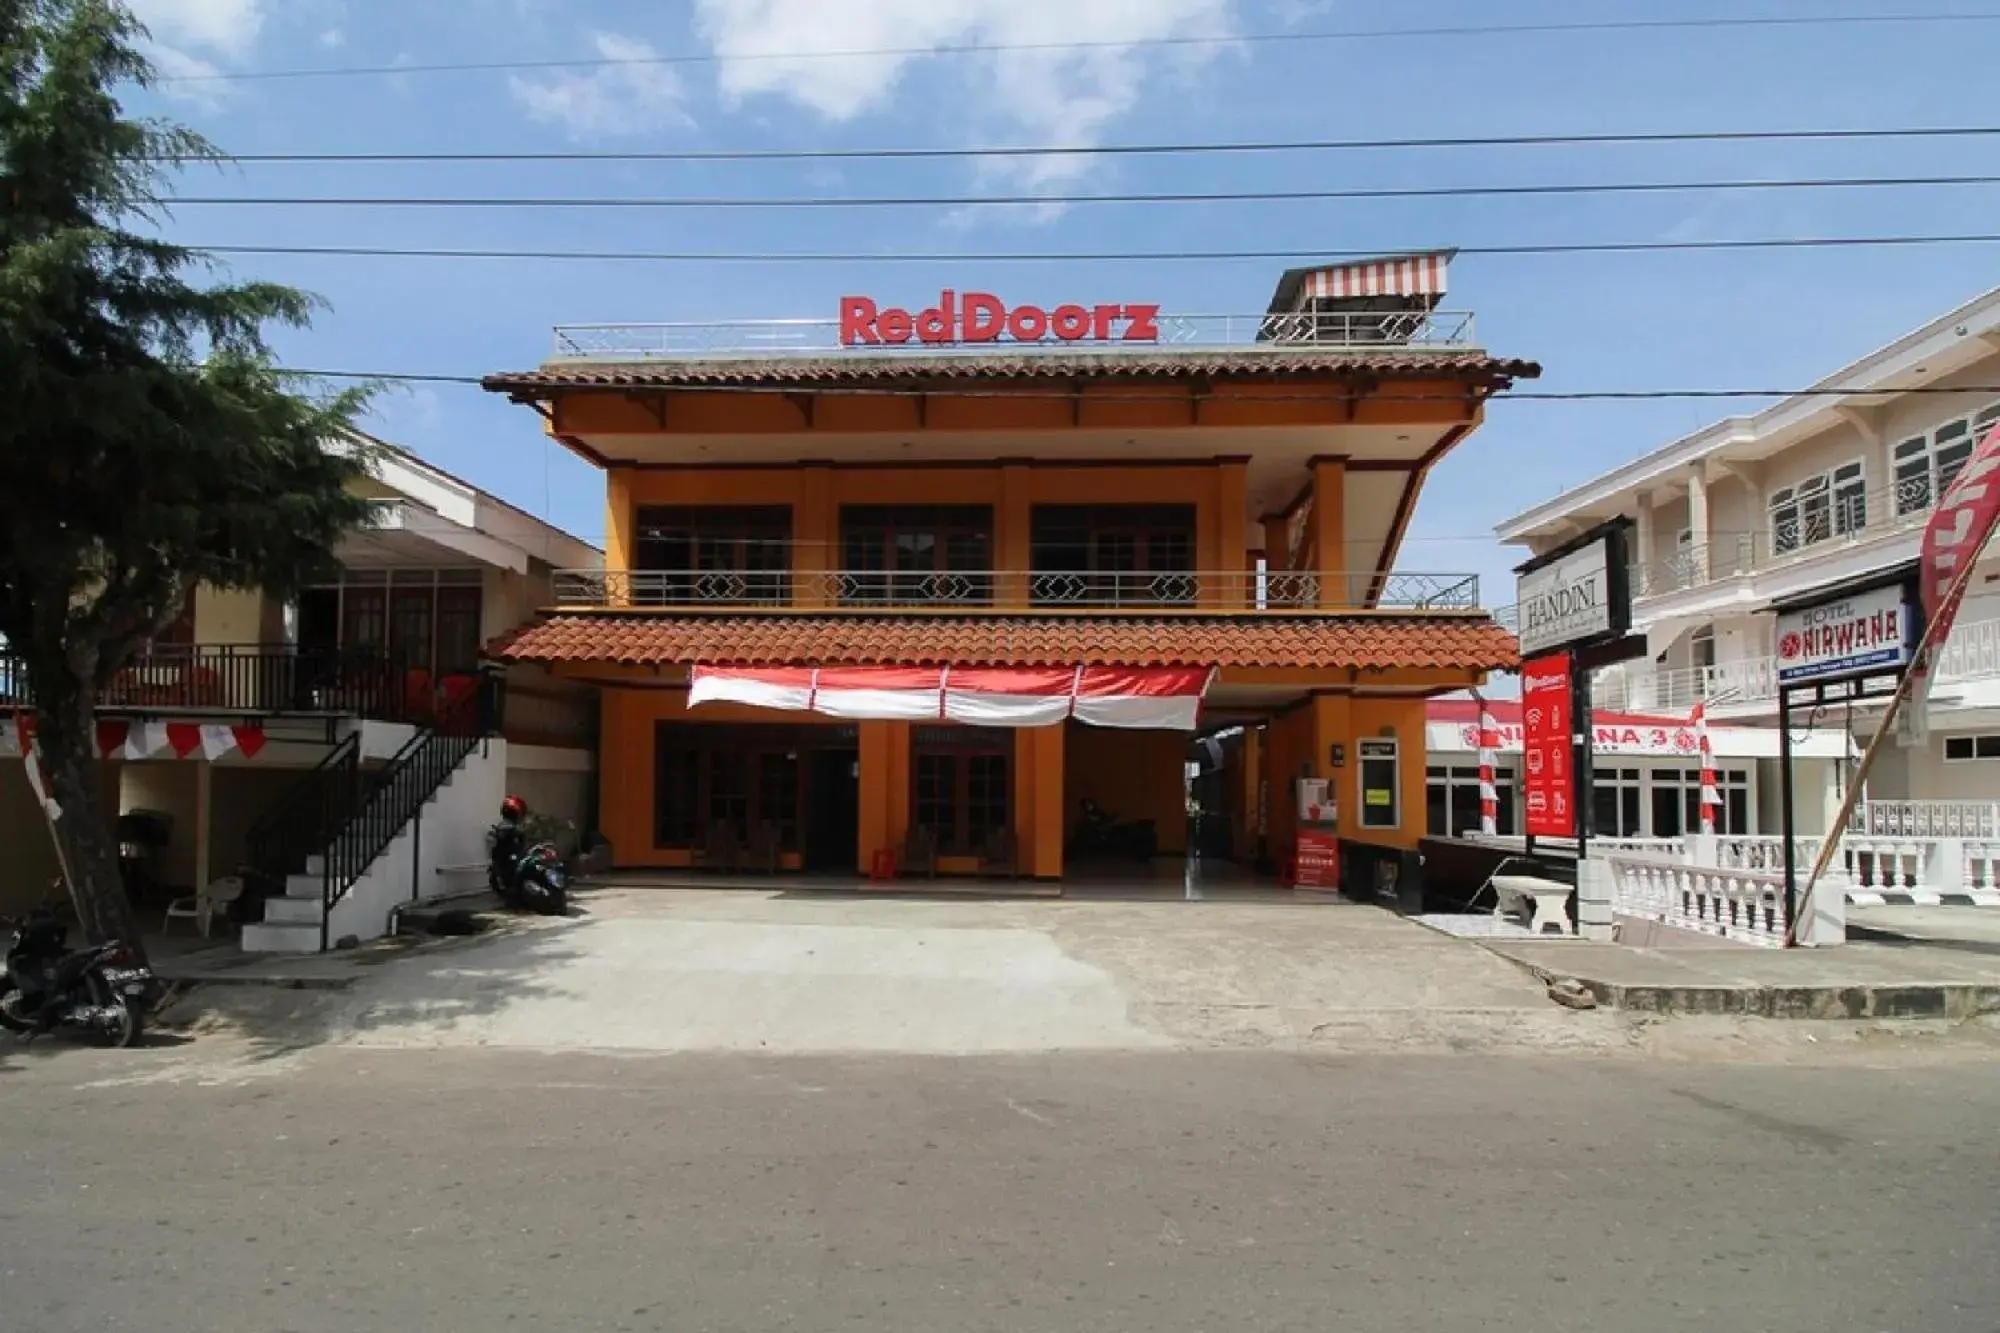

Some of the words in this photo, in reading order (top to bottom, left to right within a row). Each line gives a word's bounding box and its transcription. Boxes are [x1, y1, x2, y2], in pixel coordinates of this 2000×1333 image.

[840, 289, 1160, 345] RedDoorz
[1803, 602, 1855, 626] HOTEL
[1802, 608, 1899, 660] NIRWANA
[1650, 728, 1669, 746] 3
